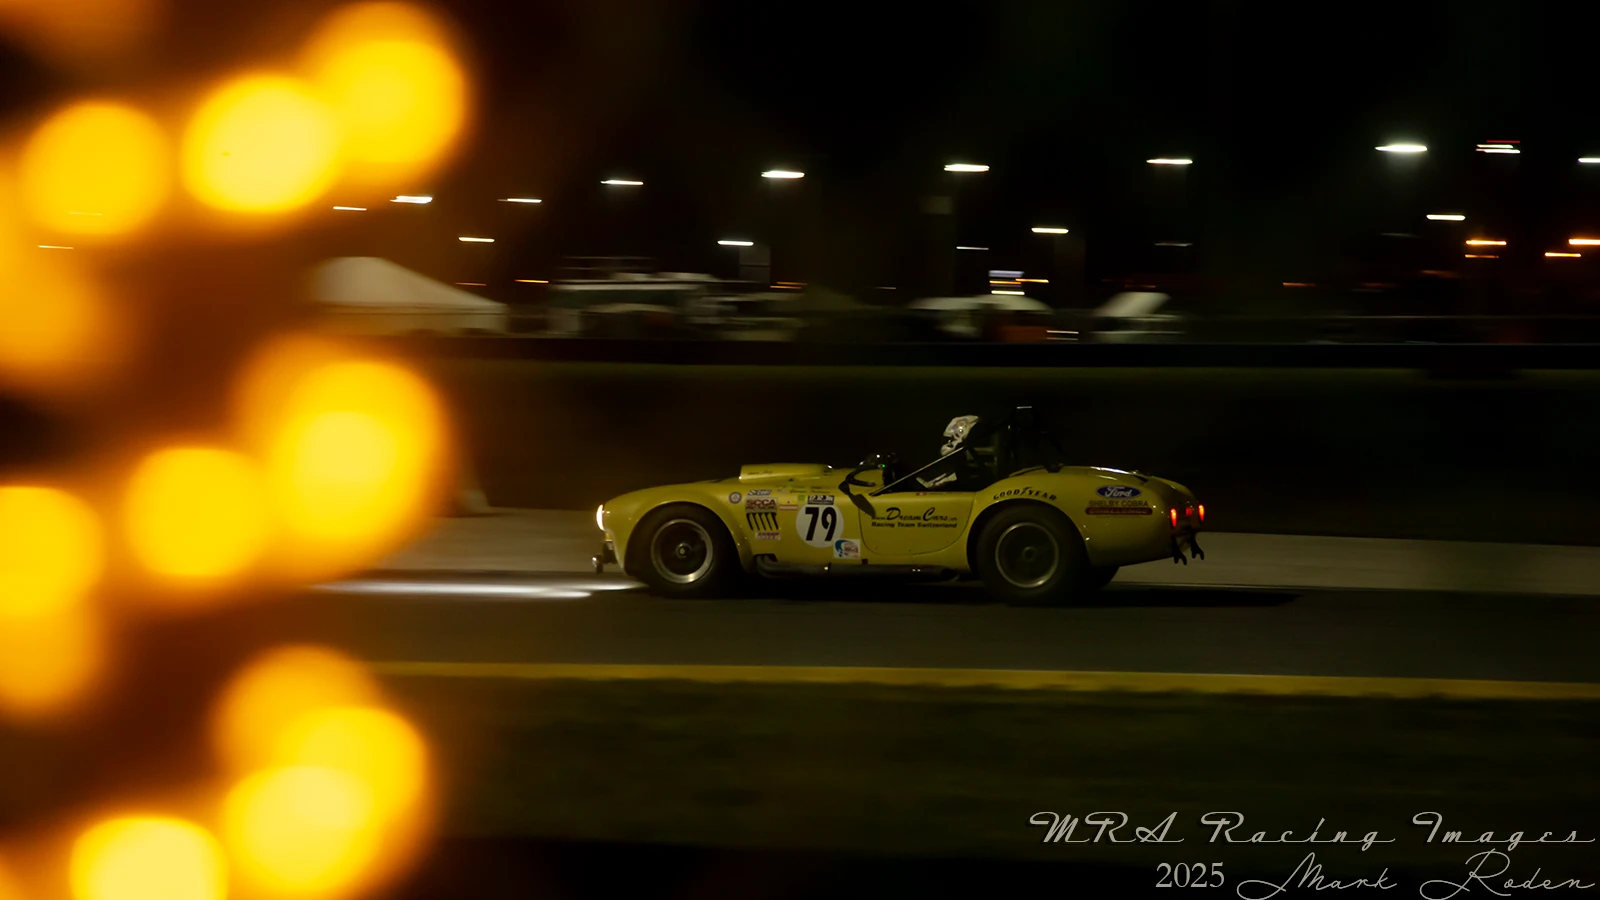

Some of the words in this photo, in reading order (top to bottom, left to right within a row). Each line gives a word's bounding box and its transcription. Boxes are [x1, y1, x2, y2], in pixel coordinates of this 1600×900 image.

[993, 486, 1057, 501] GOODYEAR
[1105, 485, 1133, 498] Ford
[805, 507, 837, 541] 79
